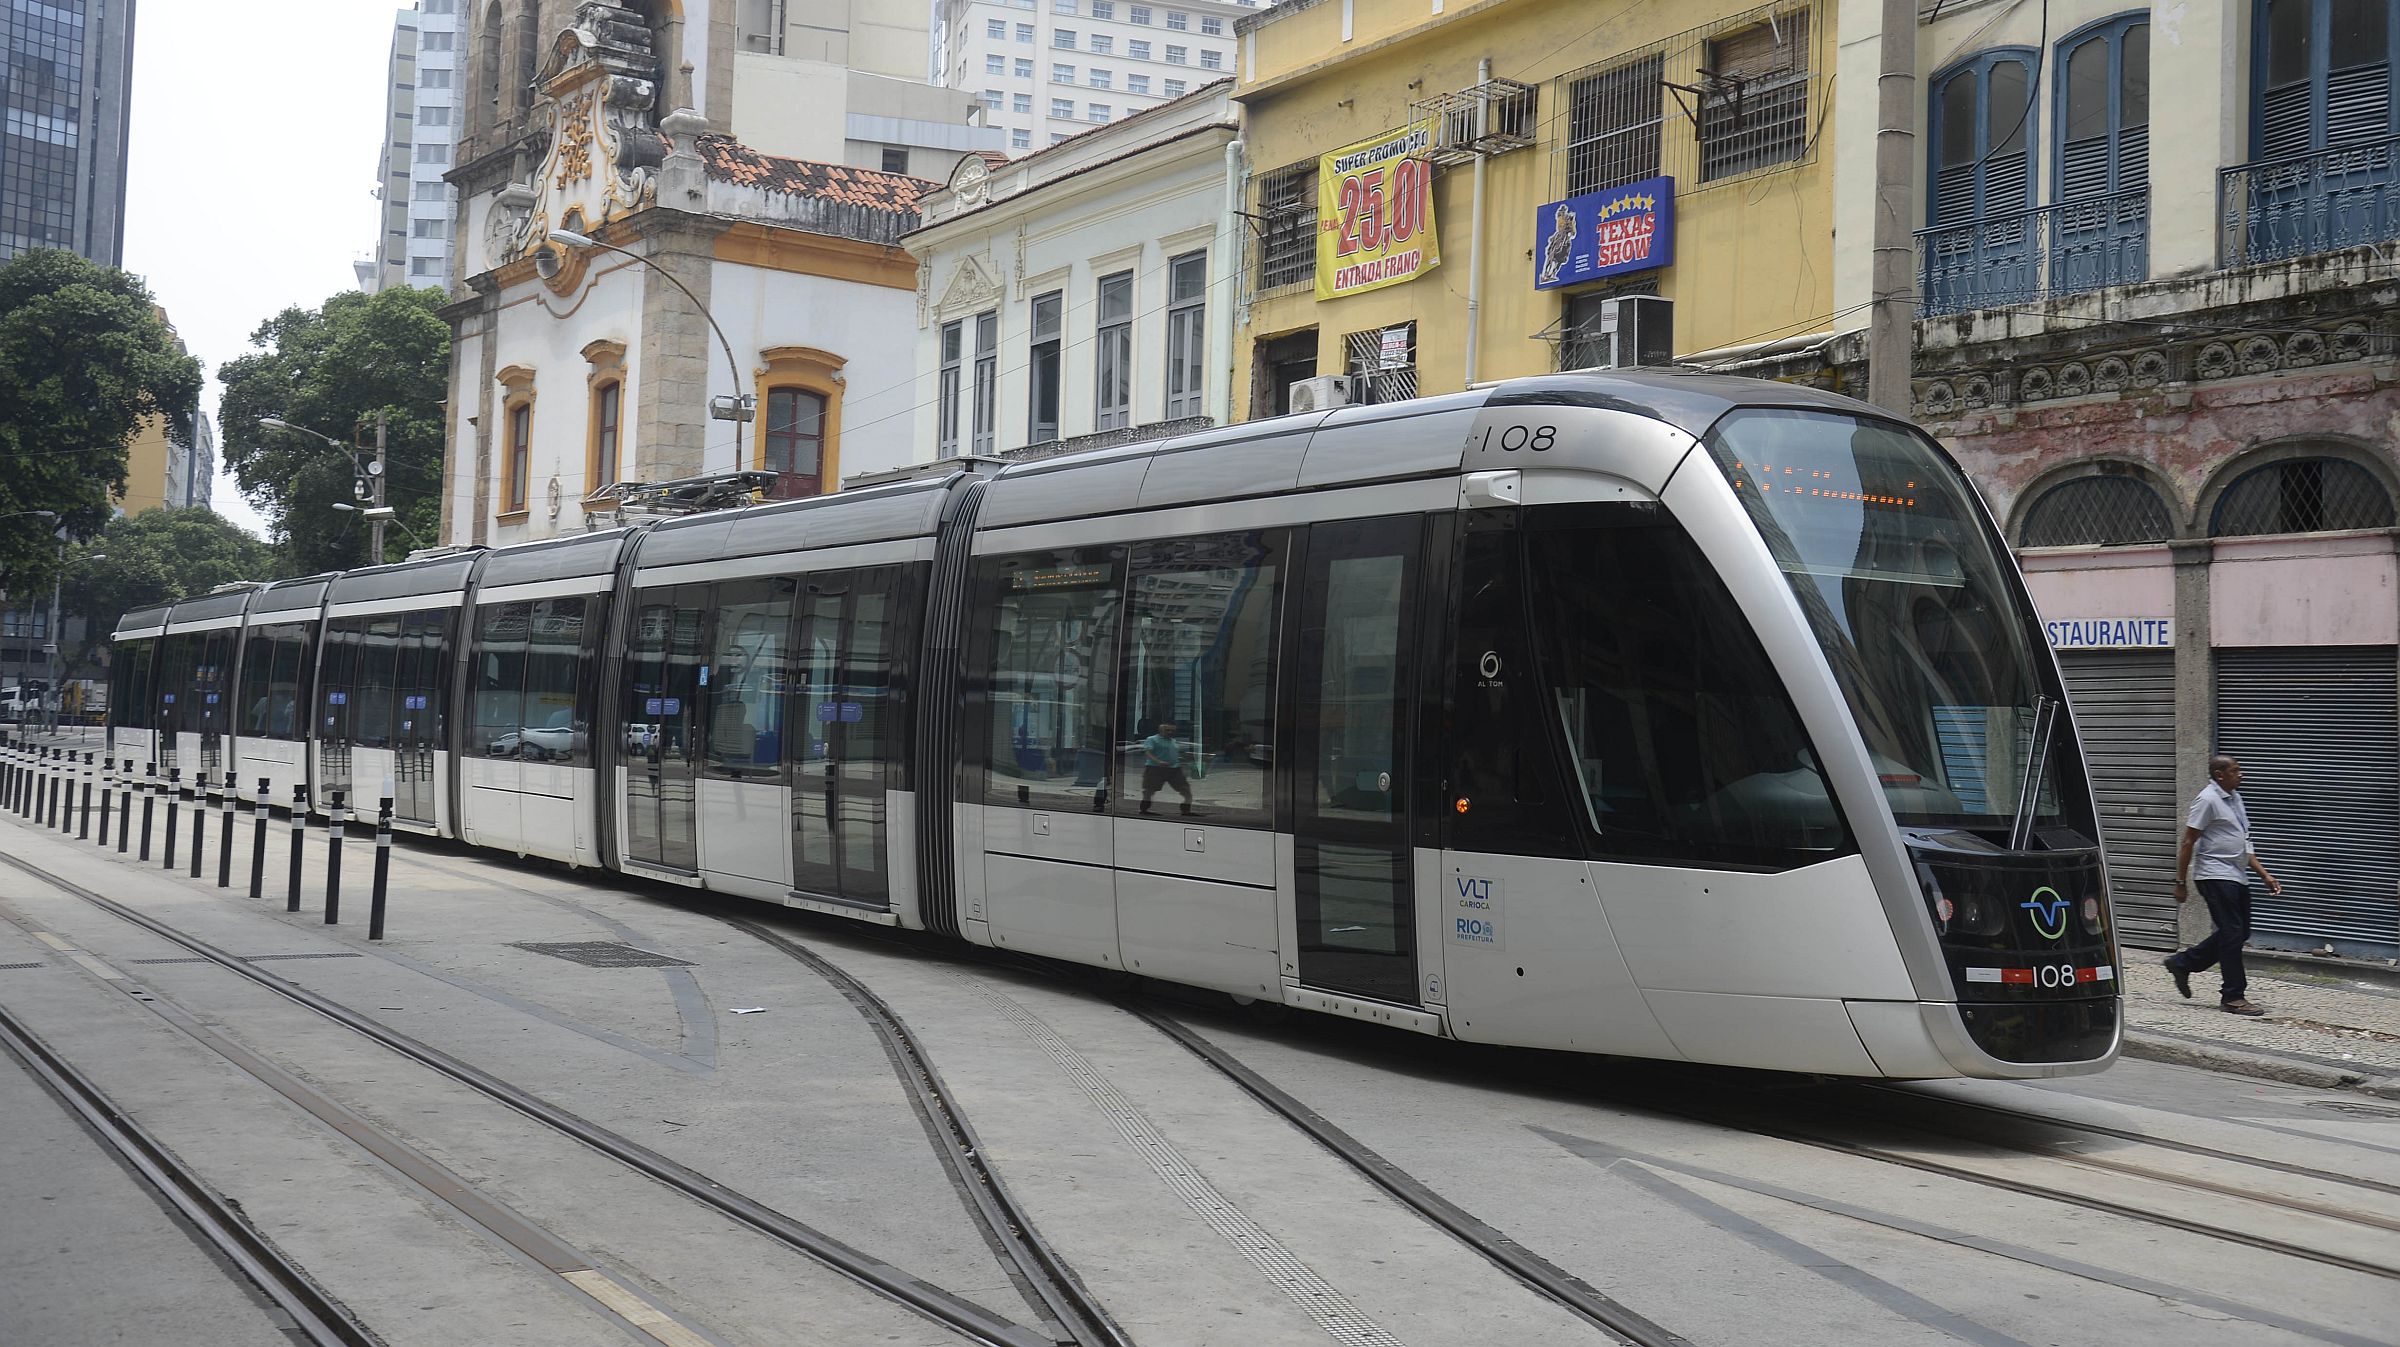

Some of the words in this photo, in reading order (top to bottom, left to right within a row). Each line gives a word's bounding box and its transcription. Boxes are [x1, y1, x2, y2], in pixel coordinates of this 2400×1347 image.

[1335, 152, 1367, 174] SUPER
[1596, 211, 1656, 244] TEXAS
[1598, 236, 1652, 268] SHOW
[1335, 260, 1382, 290] ENTRADA
[1384, 249, 1420, 278] FRANC
[1481, 425, 1557, 452] 108
[2044, 620, 2168, 646] STAURANTE
[1456, 877, 1493, 899] VLT
[1459, 900, 1490, 911] CARIOCA
[1457, 918, 1482, 935] RIO
[1457, 933, 1494, 943] PREFEITURA
[2032, 964, 2075, 988] 108
